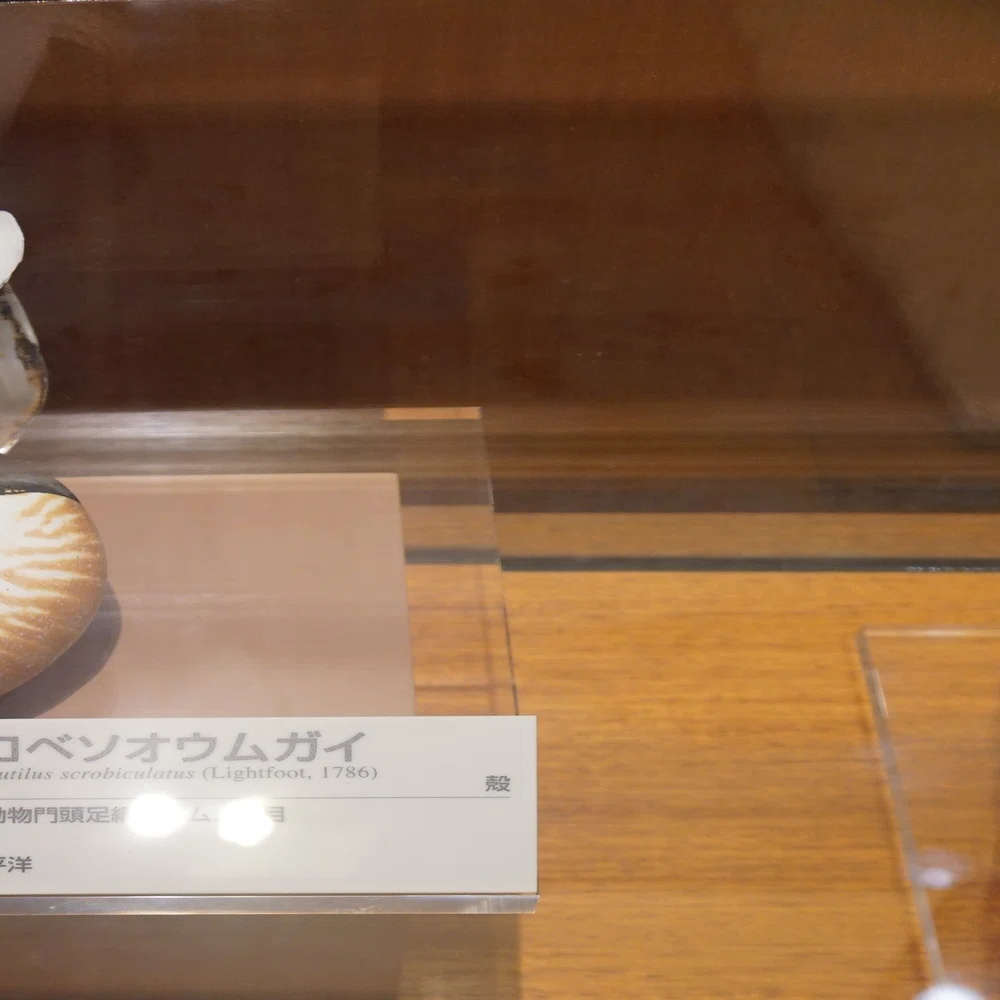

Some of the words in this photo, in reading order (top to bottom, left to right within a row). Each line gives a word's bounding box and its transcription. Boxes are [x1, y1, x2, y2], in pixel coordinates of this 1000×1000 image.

[59, 766, 194, 781] scrobiculatus
[201, 765, 312, 782] (Lightfoot,
[321, 765, 379, 781] 1786)
[485, 774, 511, 792] 殻
